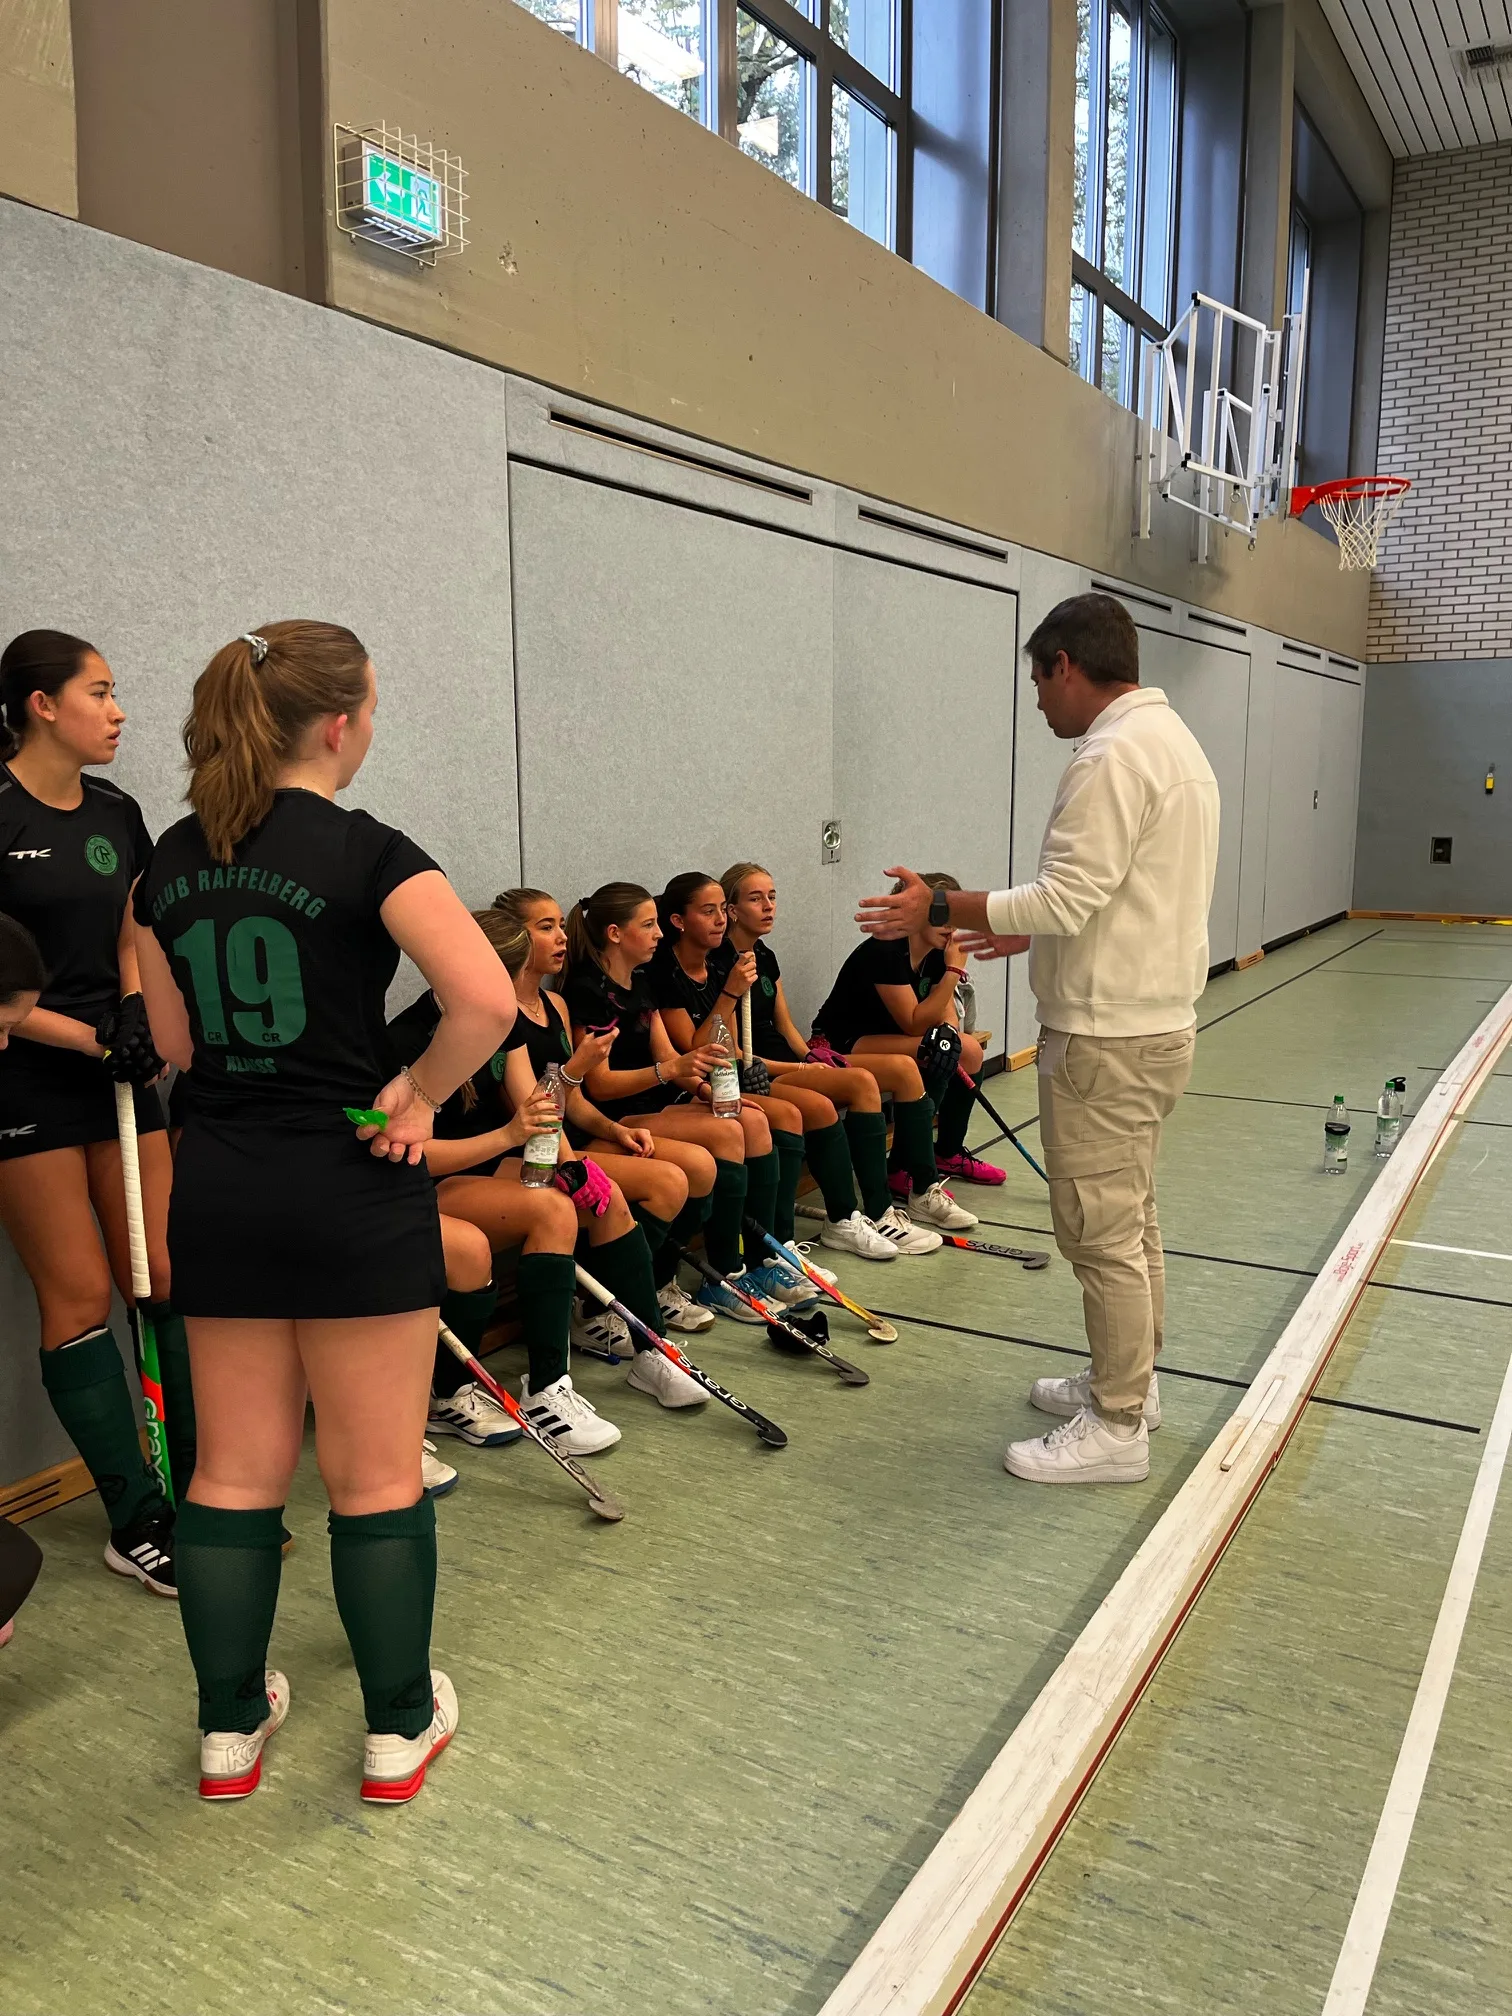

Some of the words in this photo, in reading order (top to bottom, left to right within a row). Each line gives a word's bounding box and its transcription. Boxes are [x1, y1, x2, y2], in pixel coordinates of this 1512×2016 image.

[152, 876, 191, 922] CLUB
[198, 866, 327, 921] RAFFELBERG
[172, 916, 307, 1048] 19
[207, 1031, 224, 1043] CR
[261, 1032, 281, 1043] CR
